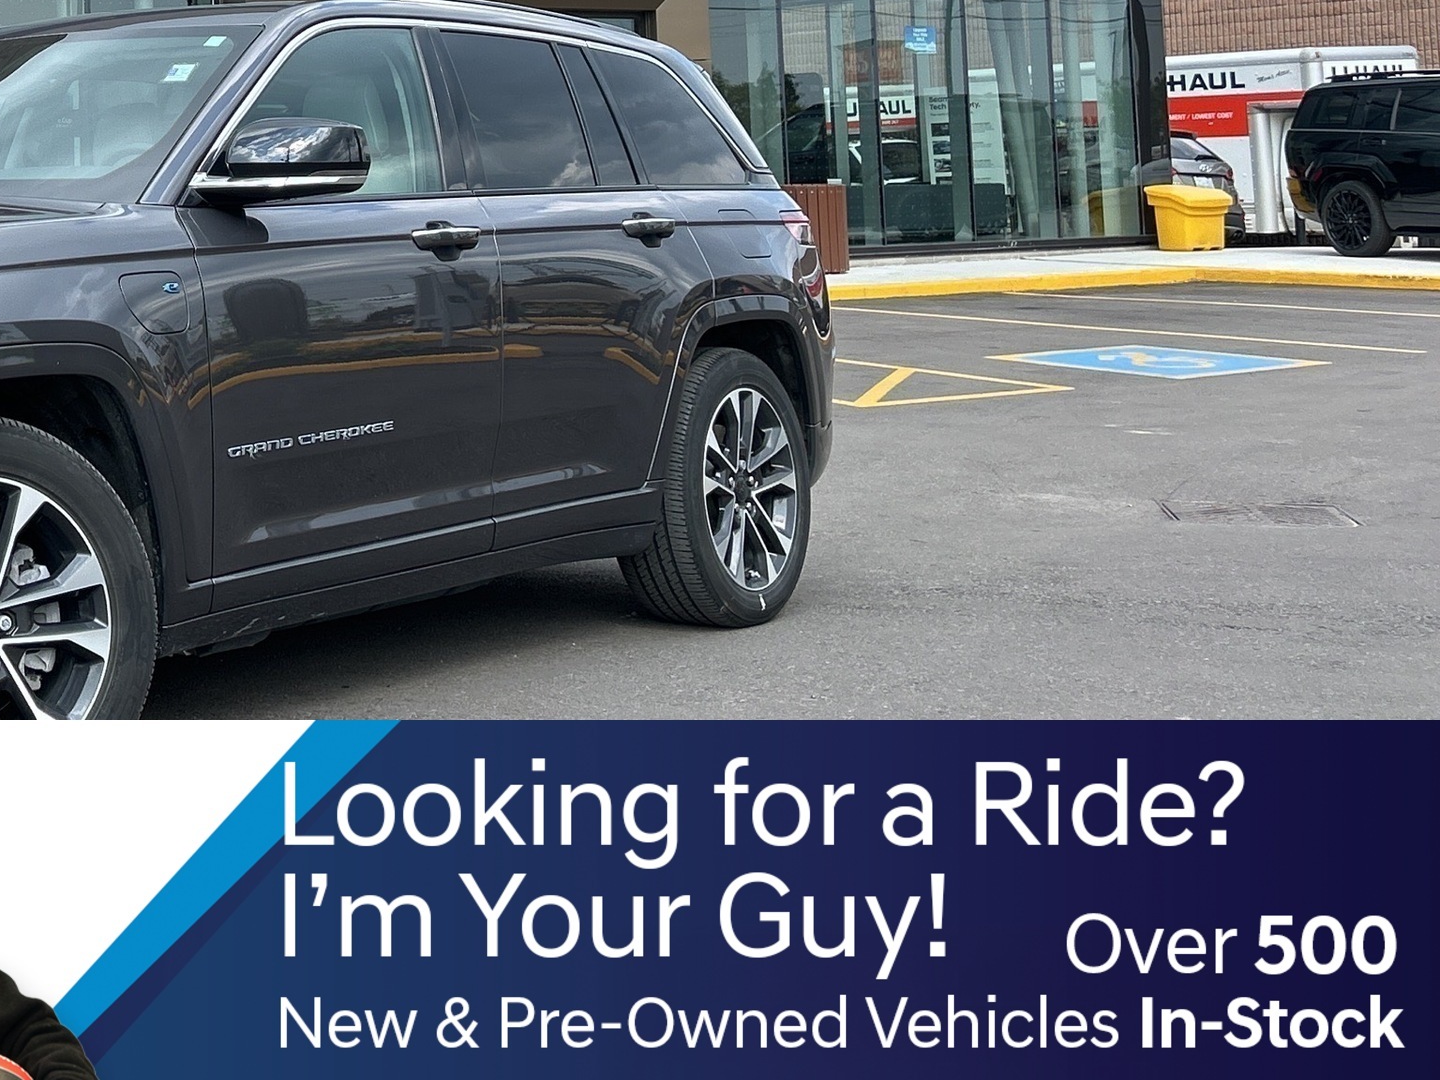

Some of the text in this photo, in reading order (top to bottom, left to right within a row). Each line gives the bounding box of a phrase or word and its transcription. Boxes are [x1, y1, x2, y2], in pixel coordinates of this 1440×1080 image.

[1167, 71, 1246, 92] -HAUL
[1216, 111, 1233, 119] COST
[227, 420, 395, 459] GRAND CHEROKEE
